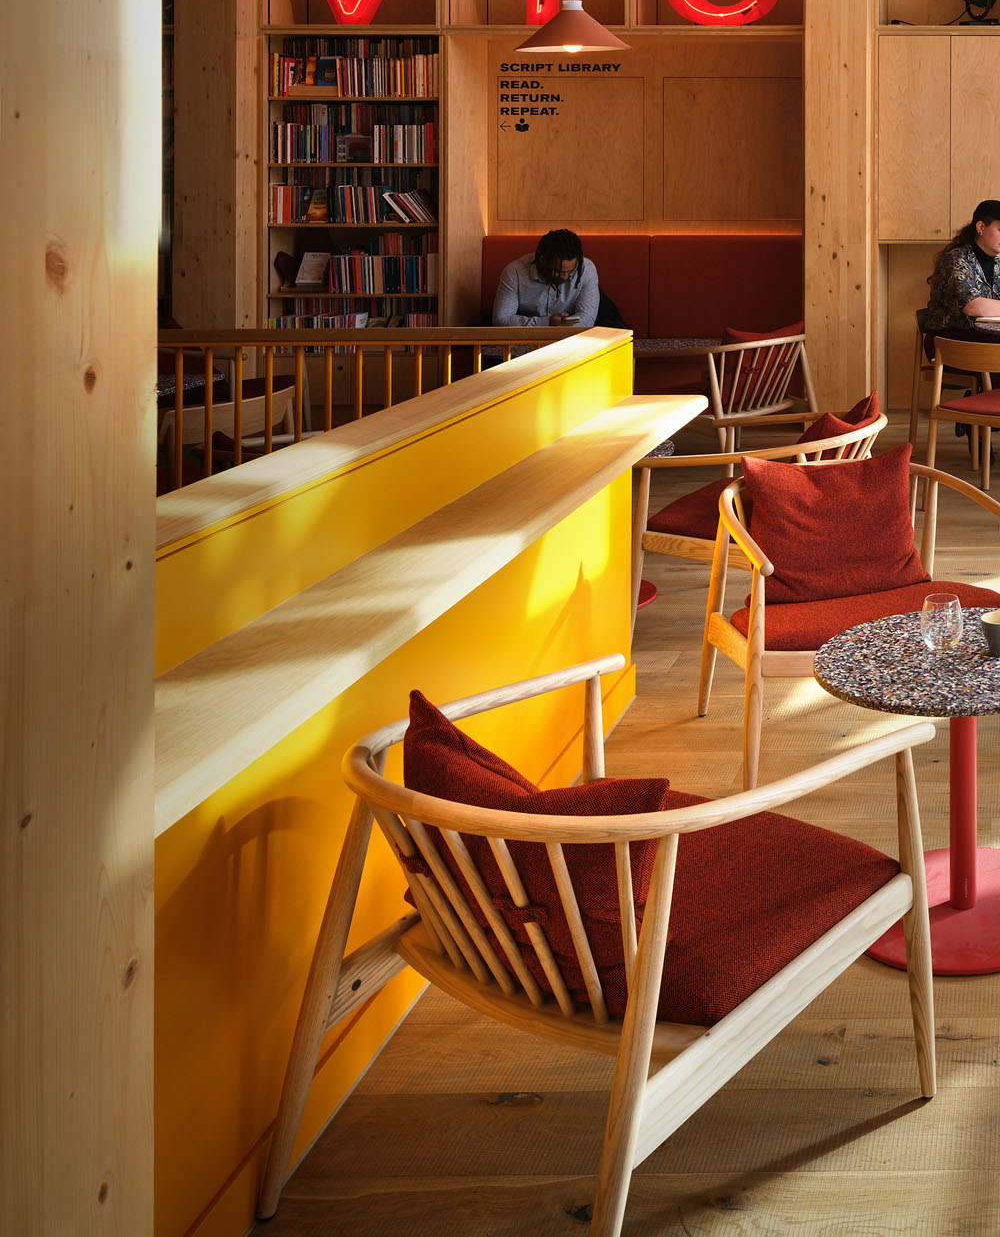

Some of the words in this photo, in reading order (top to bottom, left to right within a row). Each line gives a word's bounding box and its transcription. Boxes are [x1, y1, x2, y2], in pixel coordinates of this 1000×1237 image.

[500, 63, 554, 72] SCRIPT
[558, 63, 621, 72] LIBRARY
[500, 80, 544, 89] READ.
[500, 94, 564, 103] RETURN.
[500, 107, 559, 115] REPEAT.
